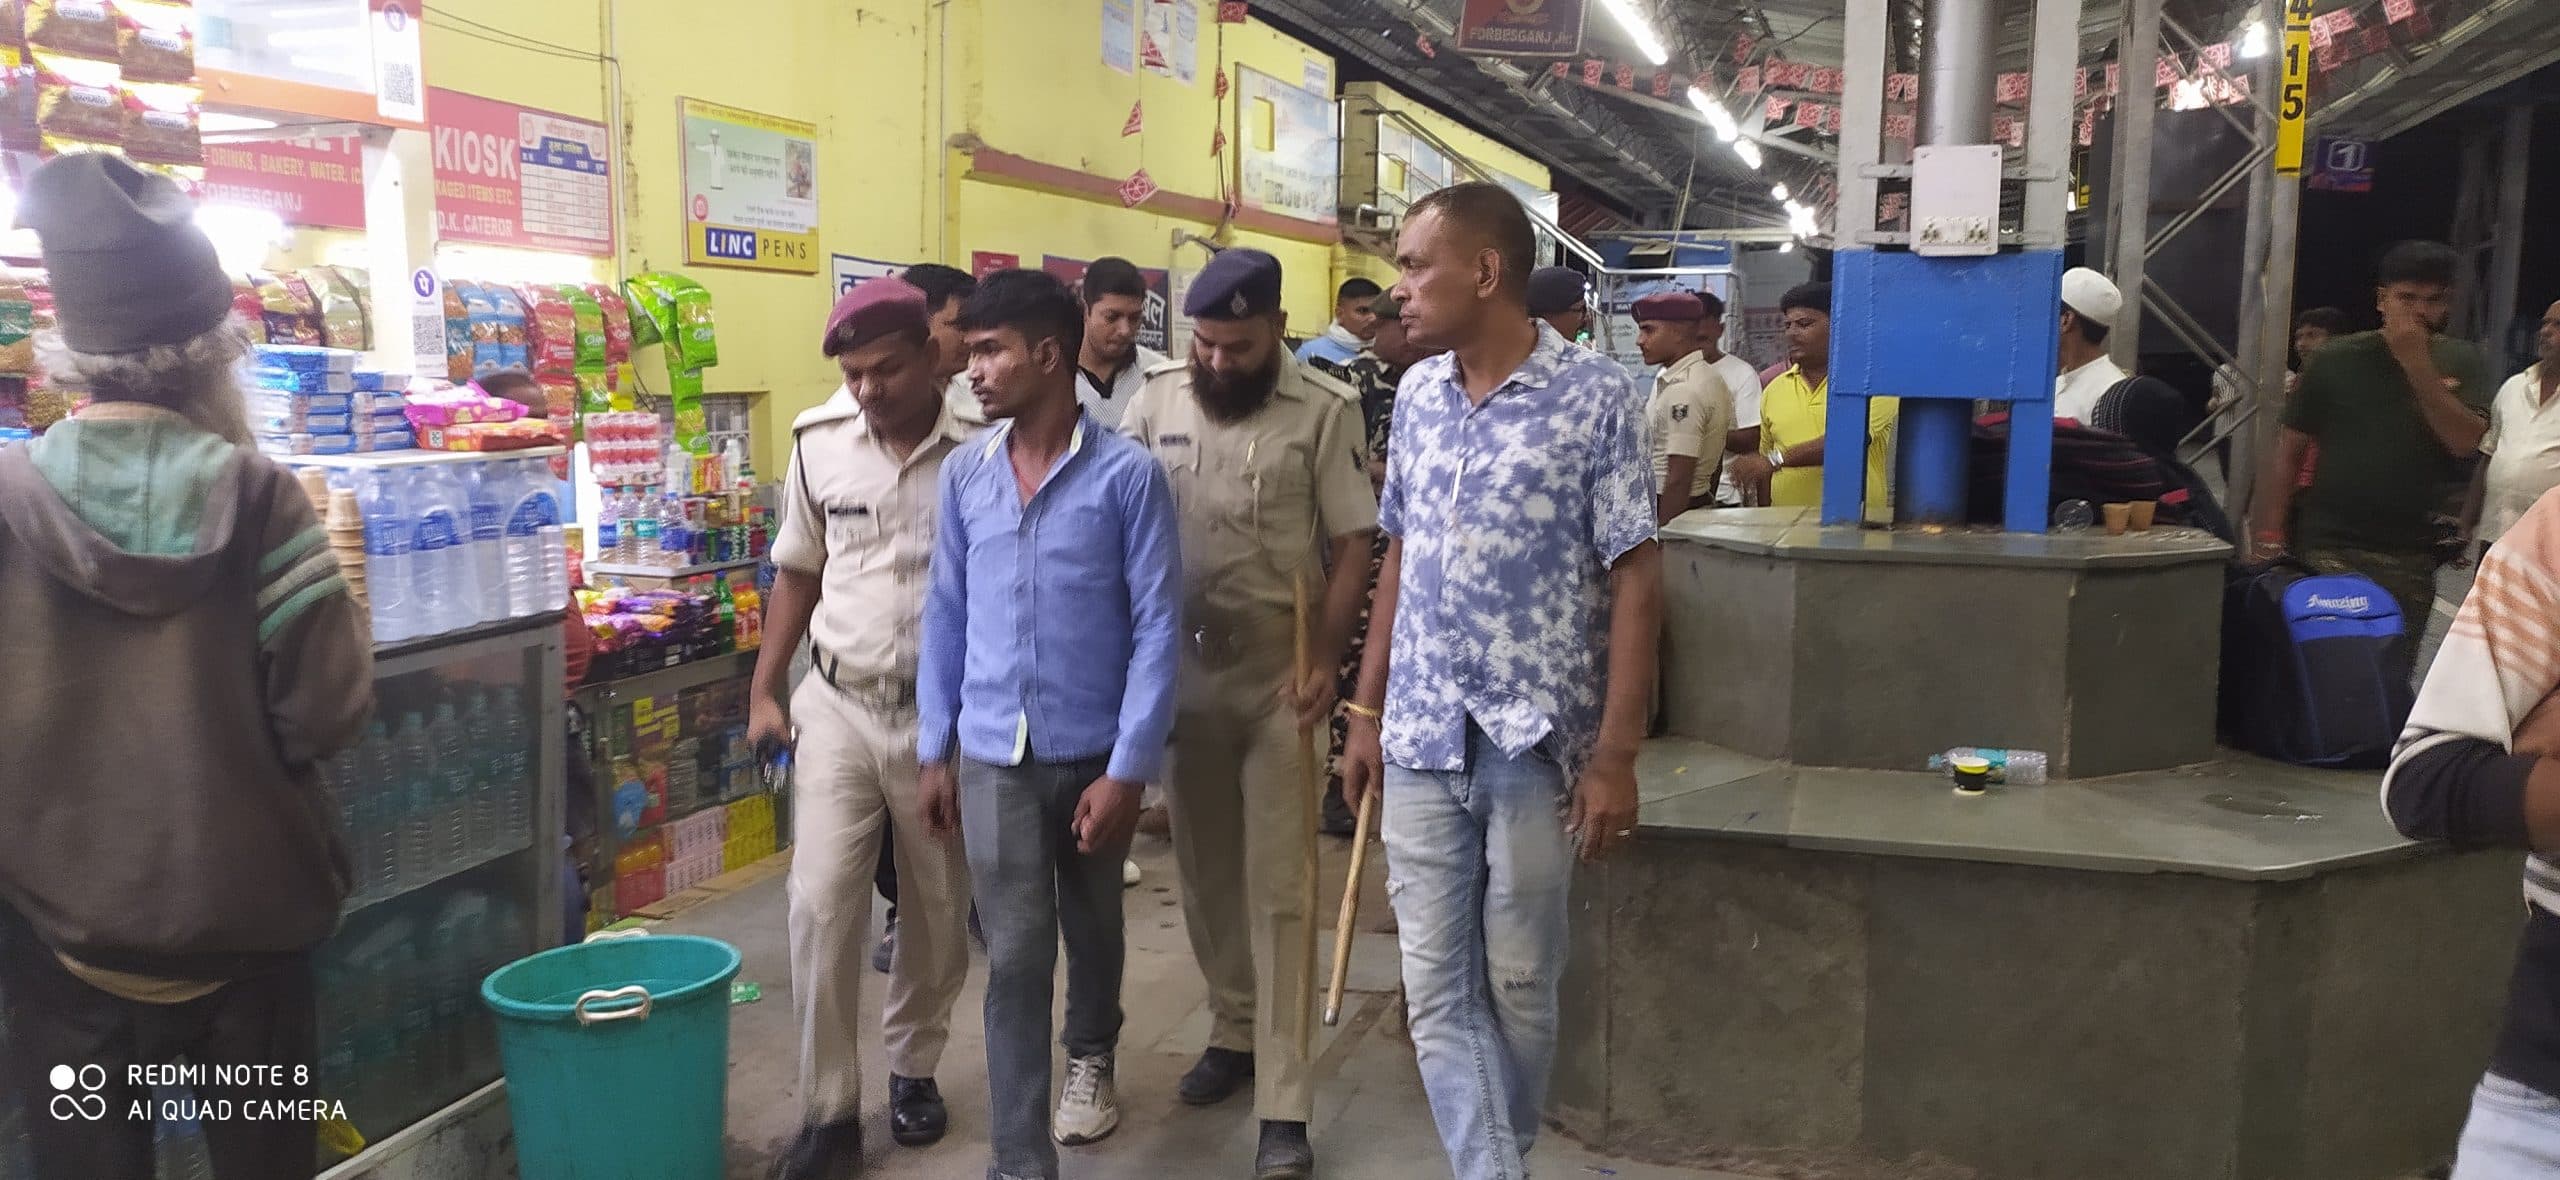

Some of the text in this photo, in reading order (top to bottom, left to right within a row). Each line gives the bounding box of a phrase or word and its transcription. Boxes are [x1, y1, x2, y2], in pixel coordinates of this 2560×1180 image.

[434, 125, 516, 181] KIOSK
[468, 183, 495, 203] ITEMS
[496, 187, 514, 205] ETC.
[464, 214, 512, 237] CATEROR
[710, 232, 806, 260] LINC PENS
[2306, 594, 2368, 613] Amazing
